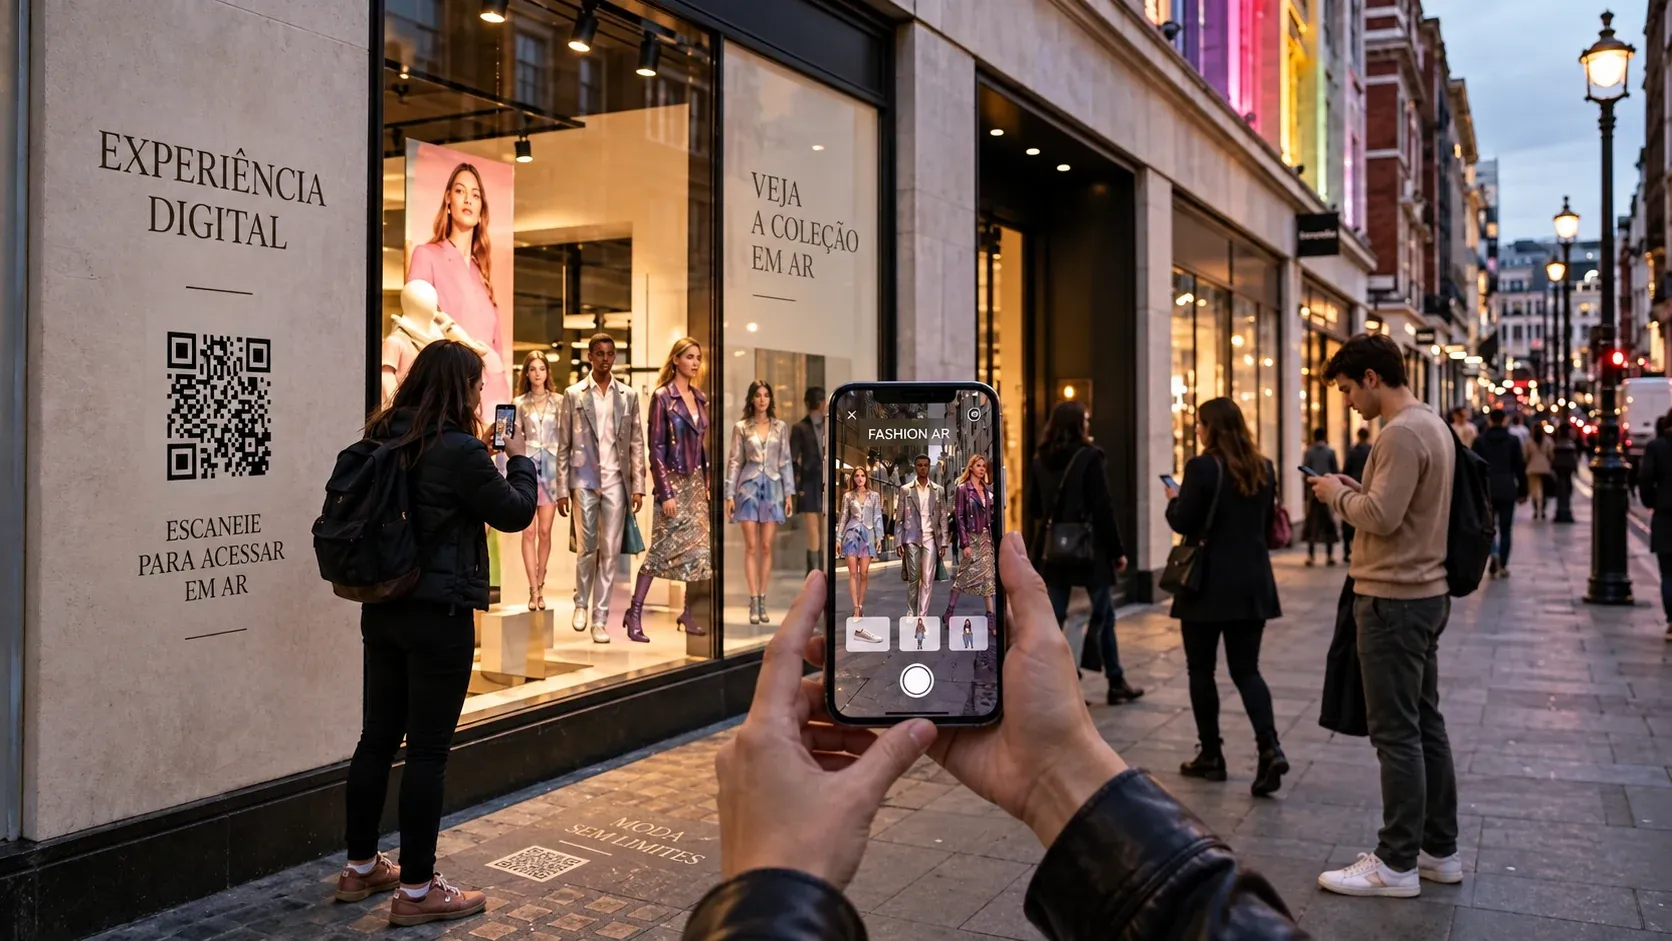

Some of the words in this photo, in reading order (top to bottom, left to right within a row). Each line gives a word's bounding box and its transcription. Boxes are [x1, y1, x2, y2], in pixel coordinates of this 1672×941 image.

[99, 129, 327, 207] EXPERIÊNCIA
[751, 171, 802, 207] VEJA
[148, 195, 287, 250] DIGITAL
[751, 210, 765, 236] A
[771, 213, 859, 254] COLEÇÃO
[752, 245, 782, 274] EM
[788, 252, 815, 278] AR
[868, 428, 928, 440] FASHION
[931, 428, 950, 439] AR
[166, 513, 262, 541] ESCANEIE
[138, 550, 195, 576] PARA
[200, 540, 285, 569] ACESSAR
[185, 578, 216, 602] EM
[221, 574, 249, 597] AR
[565, 823, 616, 841] SEM
[611, 835, 706, 865] LIMITES
[610, 817, 685, 842] MODA
